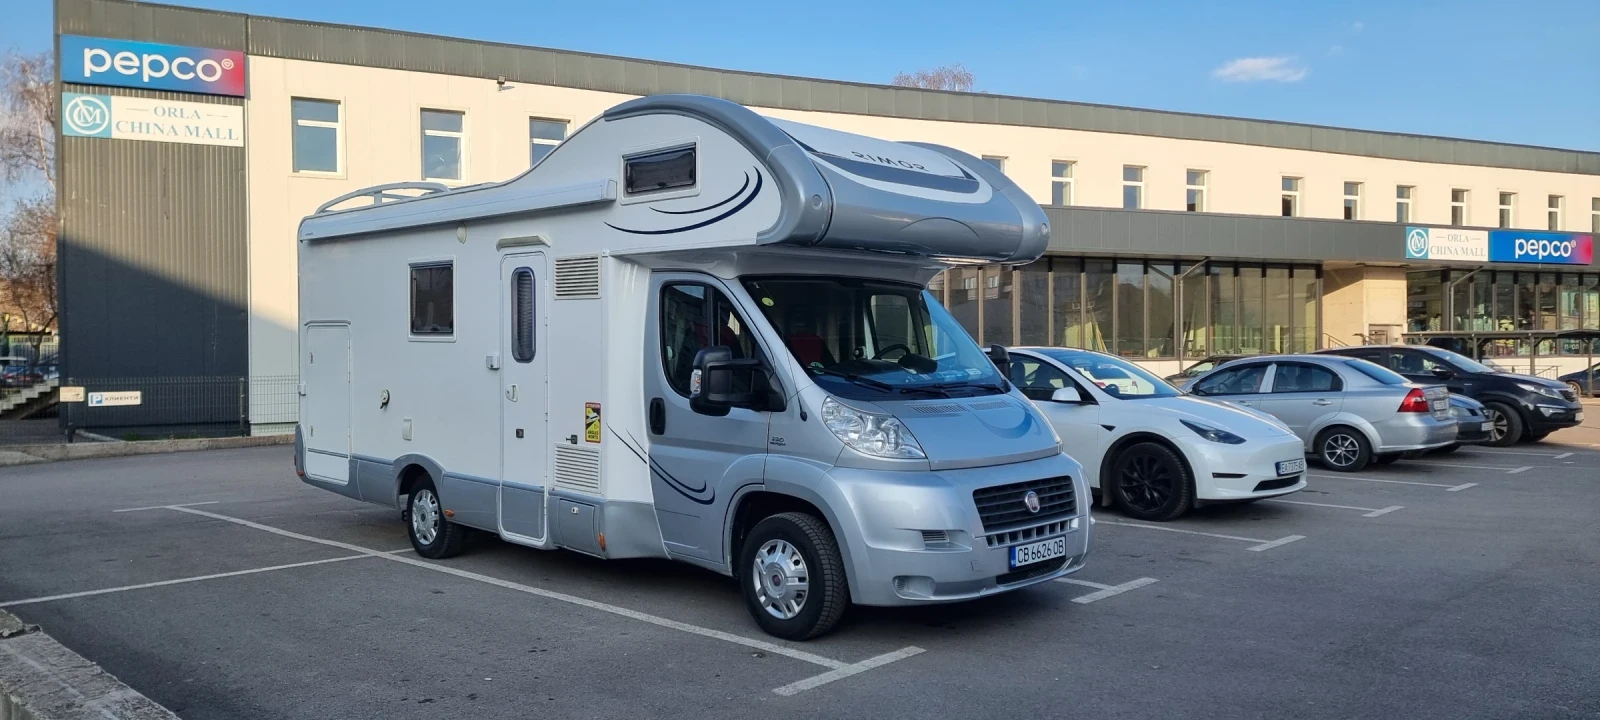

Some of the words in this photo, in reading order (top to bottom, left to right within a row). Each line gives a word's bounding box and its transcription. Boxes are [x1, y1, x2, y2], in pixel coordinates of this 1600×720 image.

[84, 47, 222, 82] pepco
[153, 106, 201, 119] ORLA
[116, 120, 179, 136] CHINA
[184, 124, 239, 141] MALL
[1447, 233, 1470, 243] ORLA
[1430, 245, 1458, 256] CHINA
[1460, 246, 1486, 257] MALL
[1515, 238, 1571, 260] pepco
[1018, 547, 1030, 563] CB
[1031, 542, 1052, 560] 6626
[1053, 539, 1064, 555] OB
